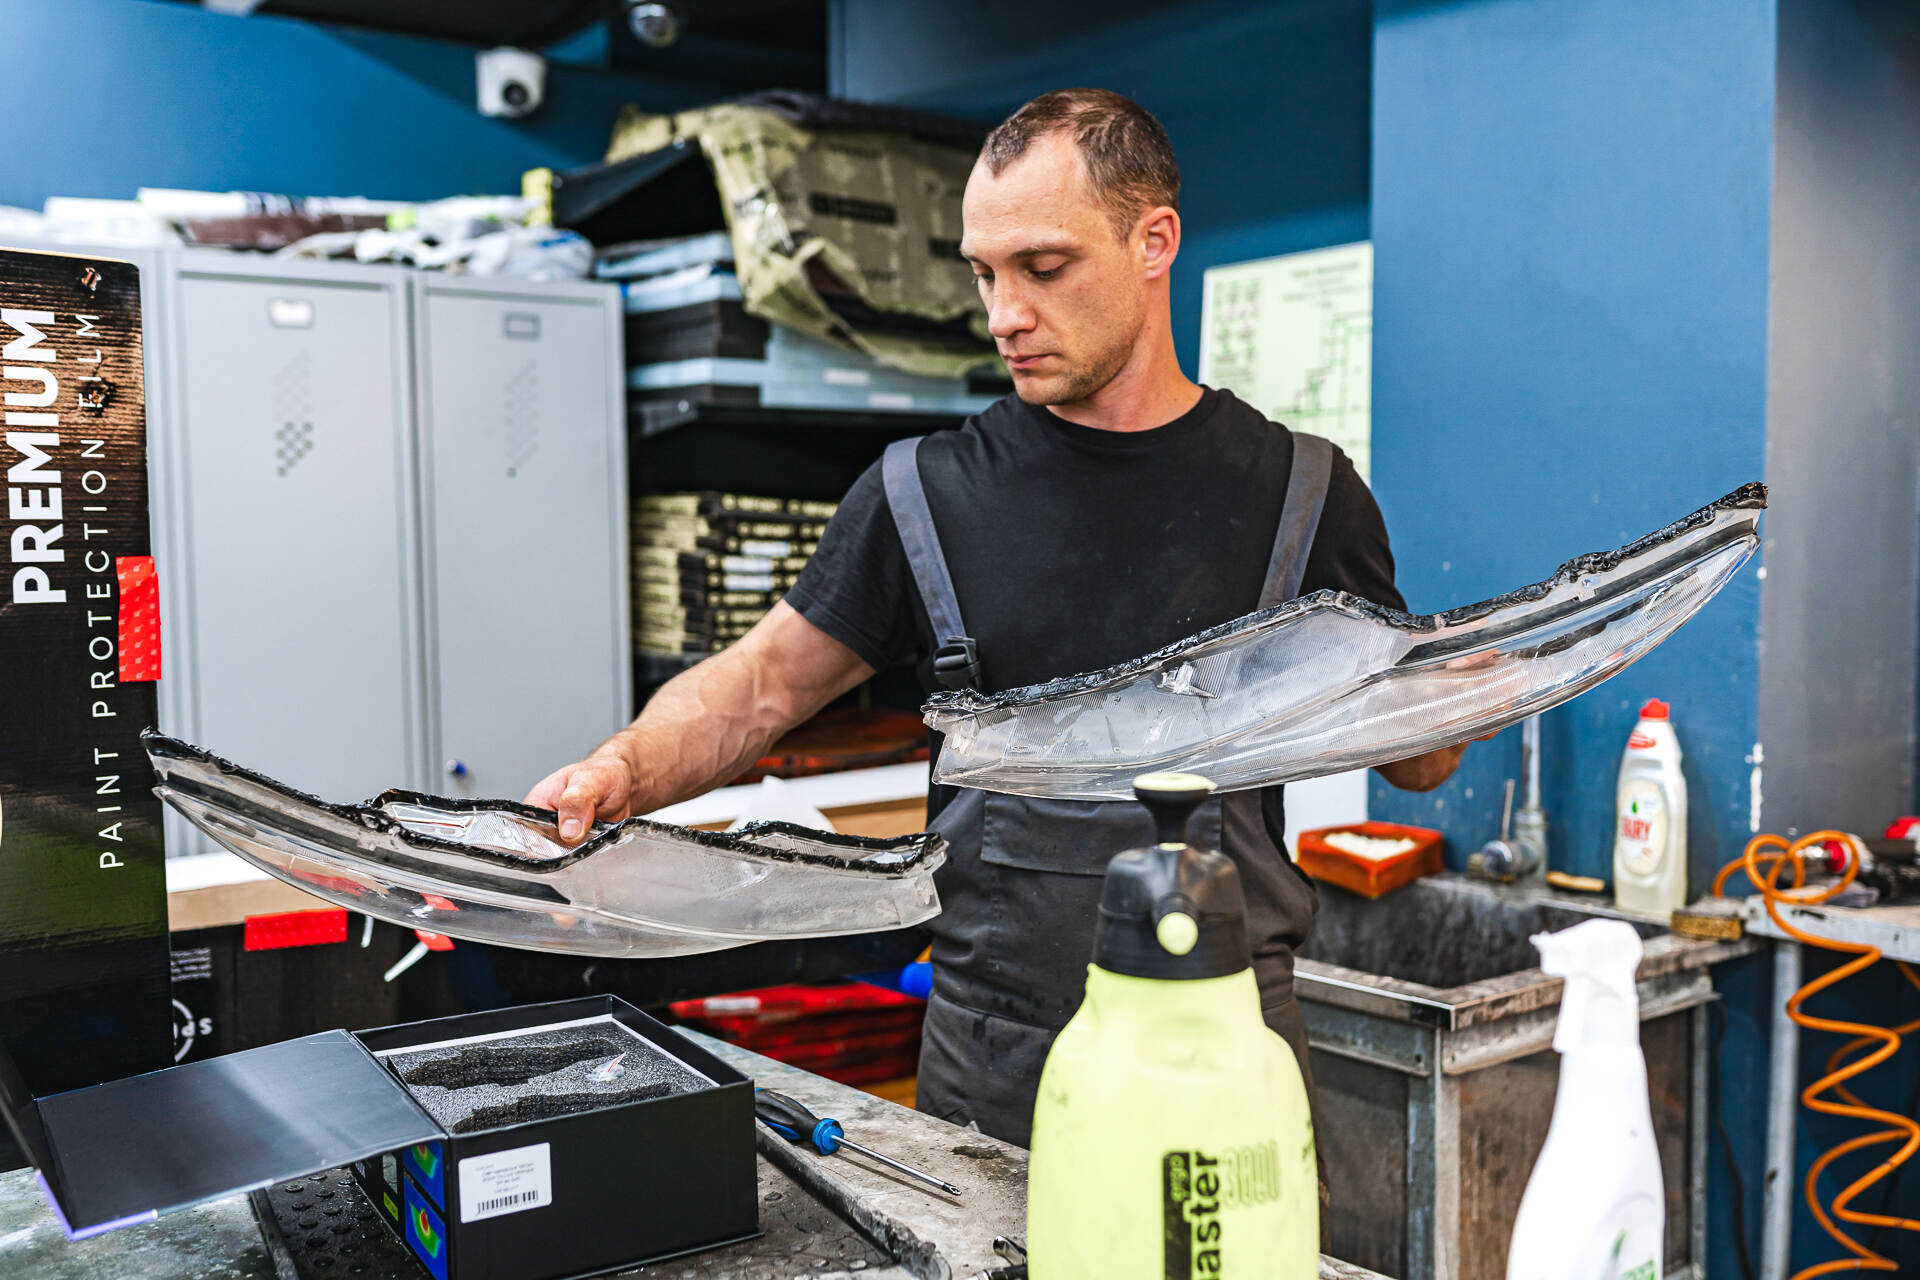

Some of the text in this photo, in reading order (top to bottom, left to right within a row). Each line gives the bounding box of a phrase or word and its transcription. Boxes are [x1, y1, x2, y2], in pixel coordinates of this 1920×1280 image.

[1, 308, 67, 604] PREMIUM
[75, 314, 125, 869] PAINT PROTECTION FILM
[1190, 1150, 1221, 1280] aster
